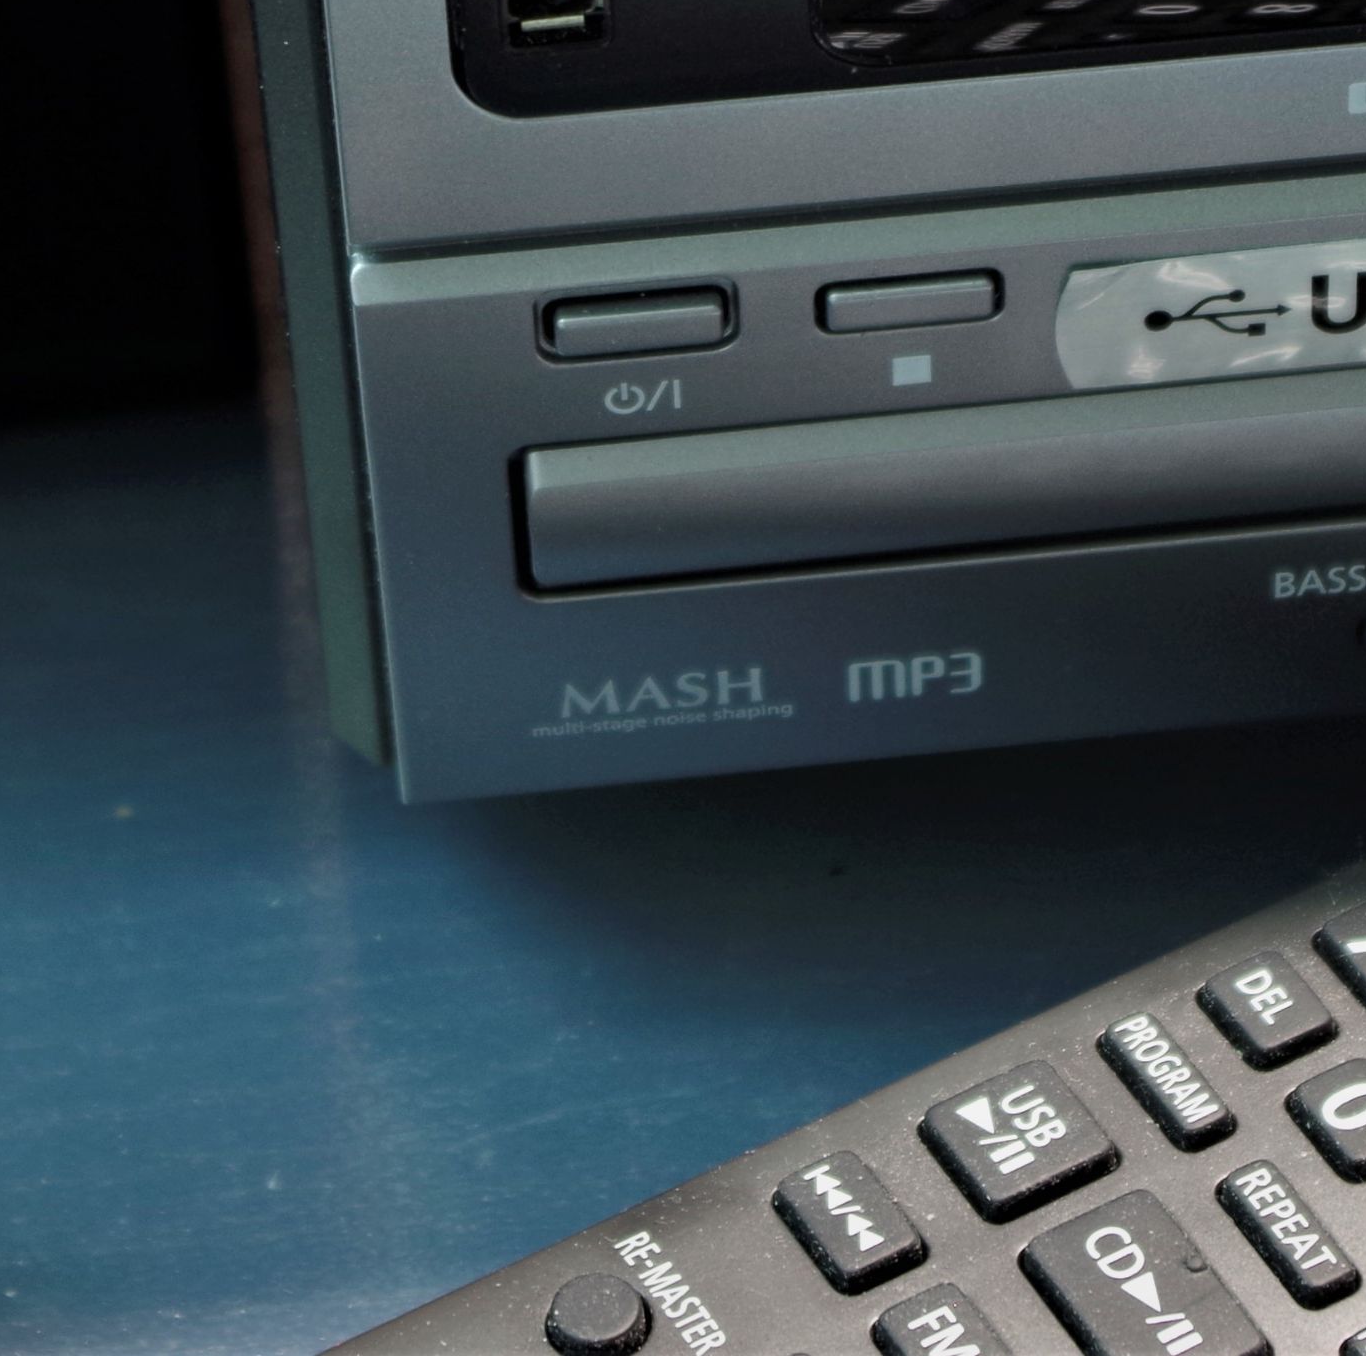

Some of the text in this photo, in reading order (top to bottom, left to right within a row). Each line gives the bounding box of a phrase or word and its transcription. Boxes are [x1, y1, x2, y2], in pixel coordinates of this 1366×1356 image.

[532, 701, 794, 738] multi-stage noise shaping
[562, 667, 765, 719] MASH
[1235, 967, 1295, 1027] DEL
[1115, 1015, 1220, 1127] PROGRAM
[1000, 1084, 1067, 1149] USB
[1235, 1166, 1338, 1272] REPEAT
[1085, 1225, 1146, 1280] CD
[615, 1230, 727, 1356] RE-MASTER
